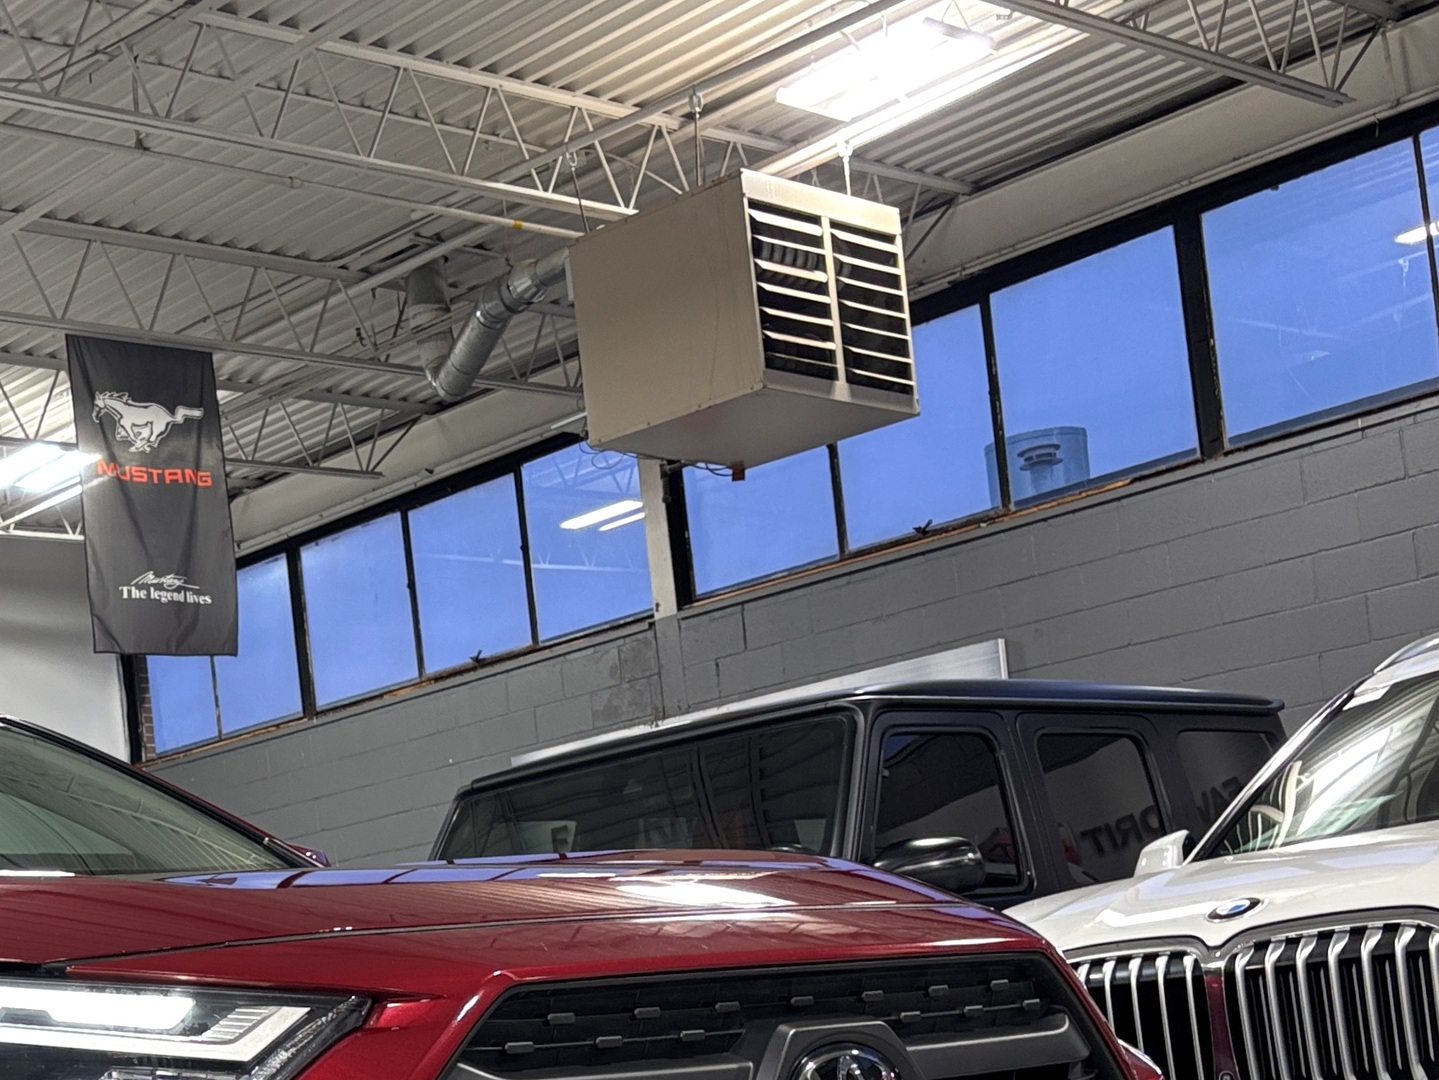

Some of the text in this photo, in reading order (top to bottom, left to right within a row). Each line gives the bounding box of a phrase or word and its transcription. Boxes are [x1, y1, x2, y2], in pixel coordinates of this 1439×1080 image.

[97, 460, 213, 487] MUSTANG
[131, 571, 200, 590] Mustang
[119, 586, 213, 605] The legend lives
